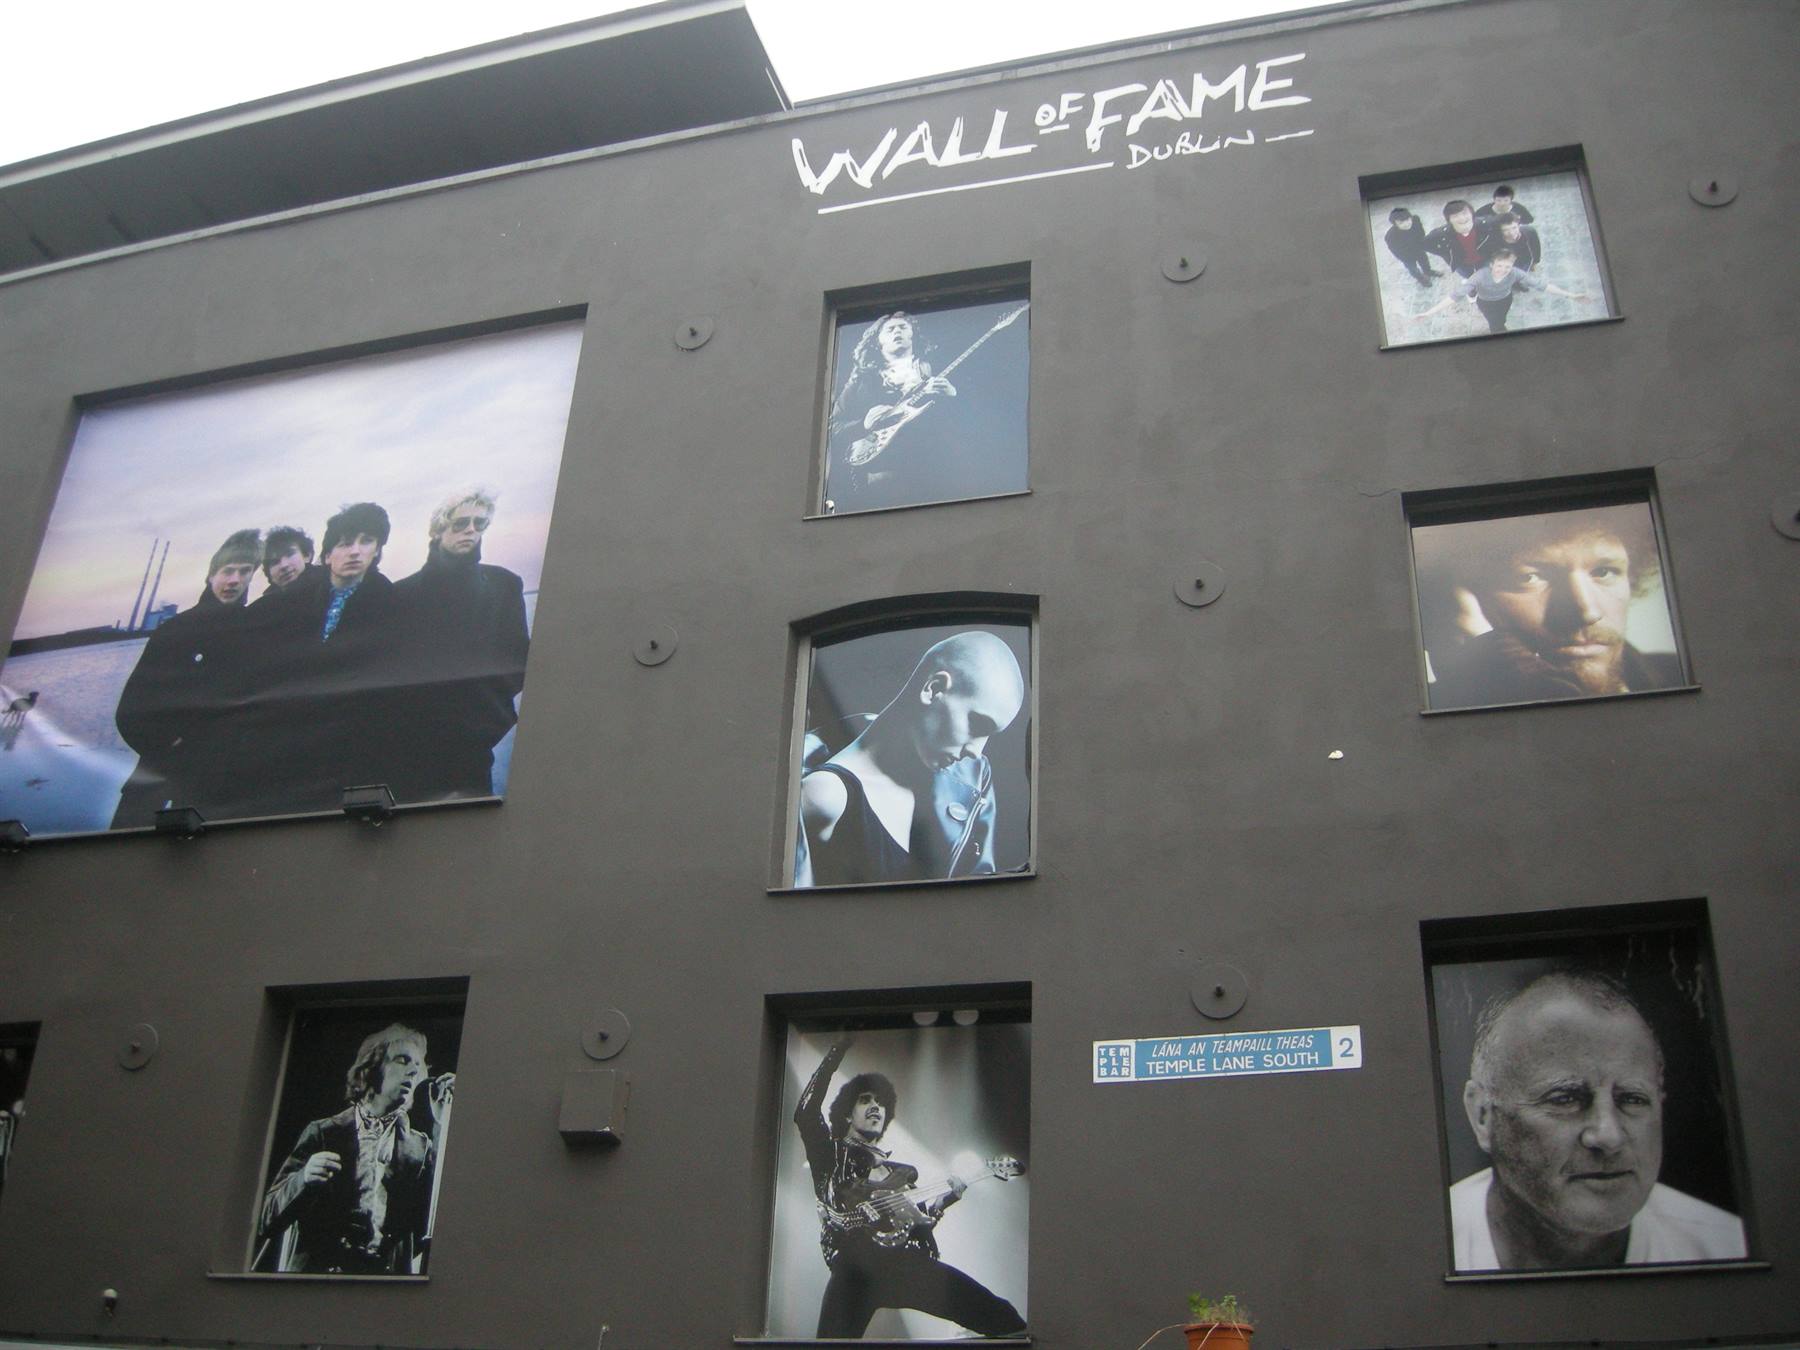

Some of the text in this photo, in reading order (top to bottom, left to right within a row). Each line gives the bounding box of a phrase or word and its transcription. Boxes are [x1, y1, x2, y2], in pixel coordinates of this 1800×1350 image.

[792, 53, 1312, 195] WALL OF FAME
[1151, 1034, 1315, 1058] LÁNA AN TEAMPAILL THEAS
[1338, 1037, 1355, 1058] 2
[1099, 1066, 1130, 1077] BAR
[1145, 1051, 1319, 1075] TEMPLE LANE SOUTH
